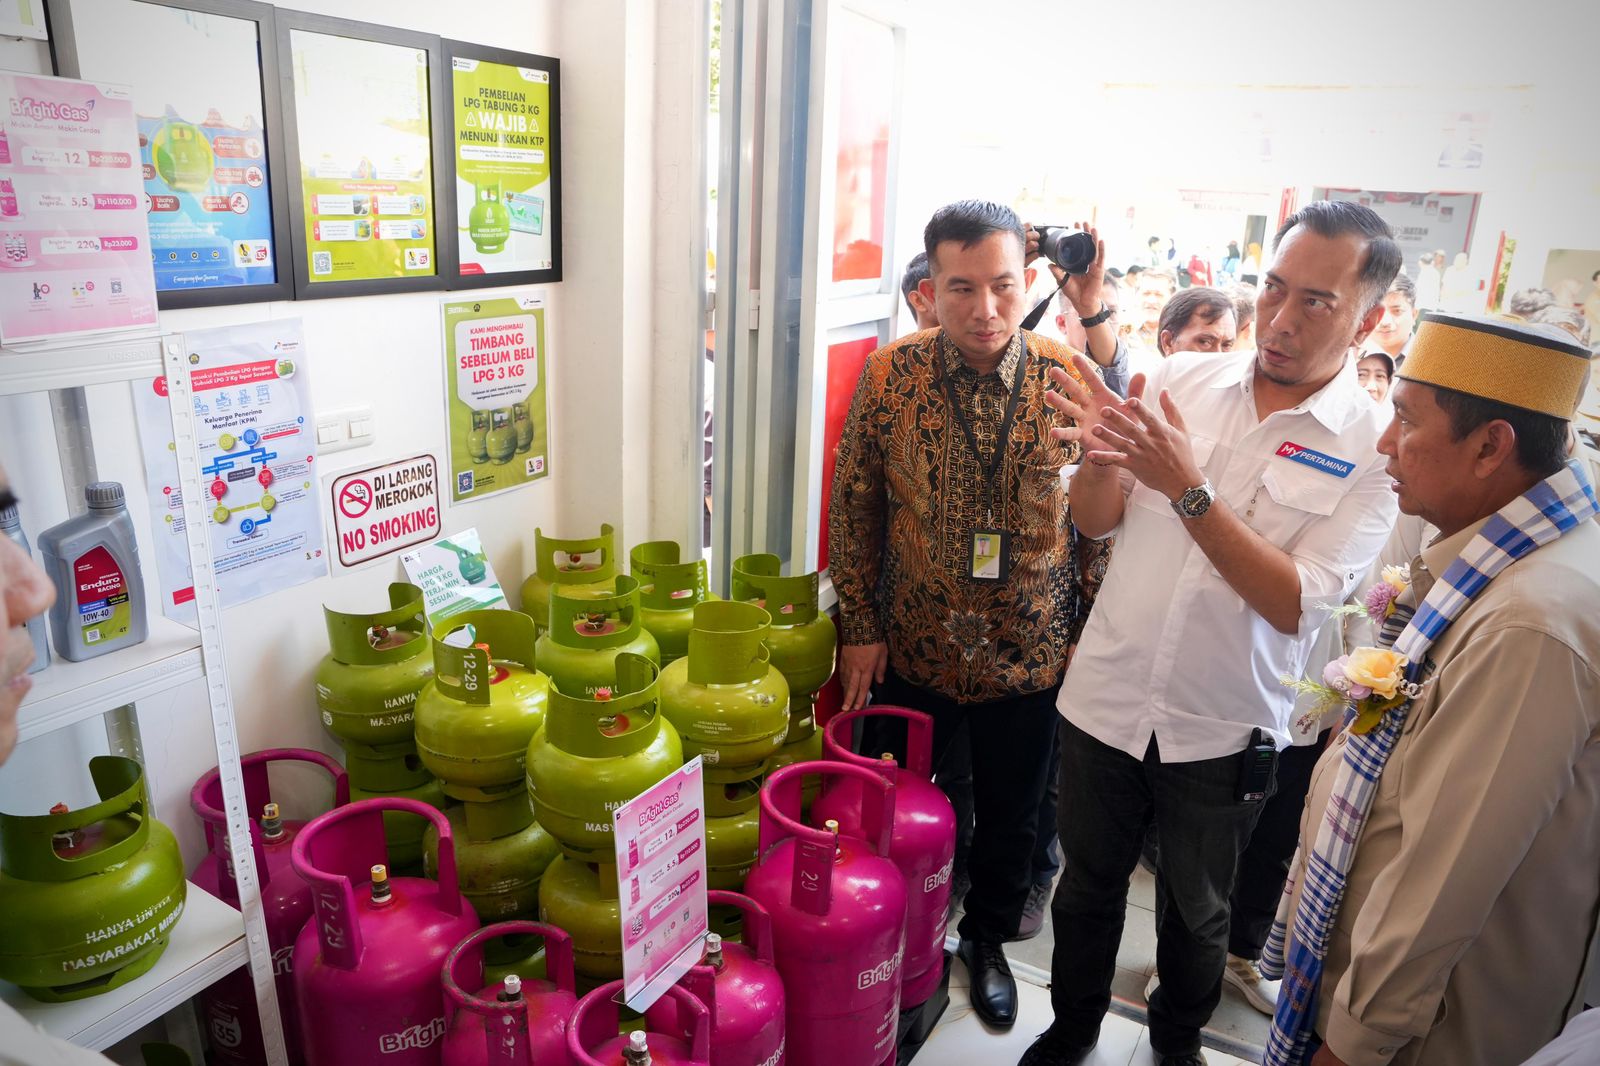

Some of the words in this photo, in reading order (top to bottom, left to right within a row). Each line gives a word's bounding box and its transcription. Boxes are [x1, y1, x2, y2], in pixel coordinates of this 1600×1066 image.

[479, 87, 526, 102] PEMBELIAN
[10, 97, 59, 121] Bright
[59, 103, 90, 122] Gas
[463, 97, 480, 109] LPG
[483, 100, 518, 113] TABUNG
[520, 104, 526, 114] 3
[528, 105, 540, 115] KG
[478, 111, 527, 133] WAJIB
[460, 131, 528, 145] MENUNJKKAN
[530, 136, 545, 146] KTP
[64, 152, 81, 164] 12
[469, 326, 486, 335] KAMI
[486, 323, 524, 333] MENGHIMBAU
[470, 333, 525, 352] TIMBANG
[460, 350, 511, 370] SEBELUM
[513, 347, 535, 362] BELI
[473, 368, 495, 384] LPG
[498, 367, 505, 380] 3
[508, 364, 525, 378] KG
[204, 413, 234, 425] Keluarga
[234, 409, 263, 418] Penerima
[212, 421, 238, 430] Manfaat
[240, 416, 258, 426] (KPM)
[1300, 450, 1348, 473] PERTAMINA
[374, 474, 386, 492] DI
[389, 463, 433, 488] LARANG
[375, 481, 434, 511] MEROKOK
[343, 528, 366, 554] NO
[369, 506, 437, 546] SMOKING
[417, 564, 445, 580] HARGA
[421, 577, 436, 589] LPG
[442, 570, 454, 581] KG
[80, 577, 120, 592] Enduro
[97, 583, 121, 593] RACING
[428, 590, 455, 607] SESUAI
[83, 608, 110, 622] 10W-40
[462, 652, 479, 692] 12-29
[384, 692, 417, 709] HANYA
[639, 801, 664, 827] Bright
[663, 792, 679, 810] Gas
[664, 829, 673, 841] 12
[86, 917, 136, 945] HANYA
